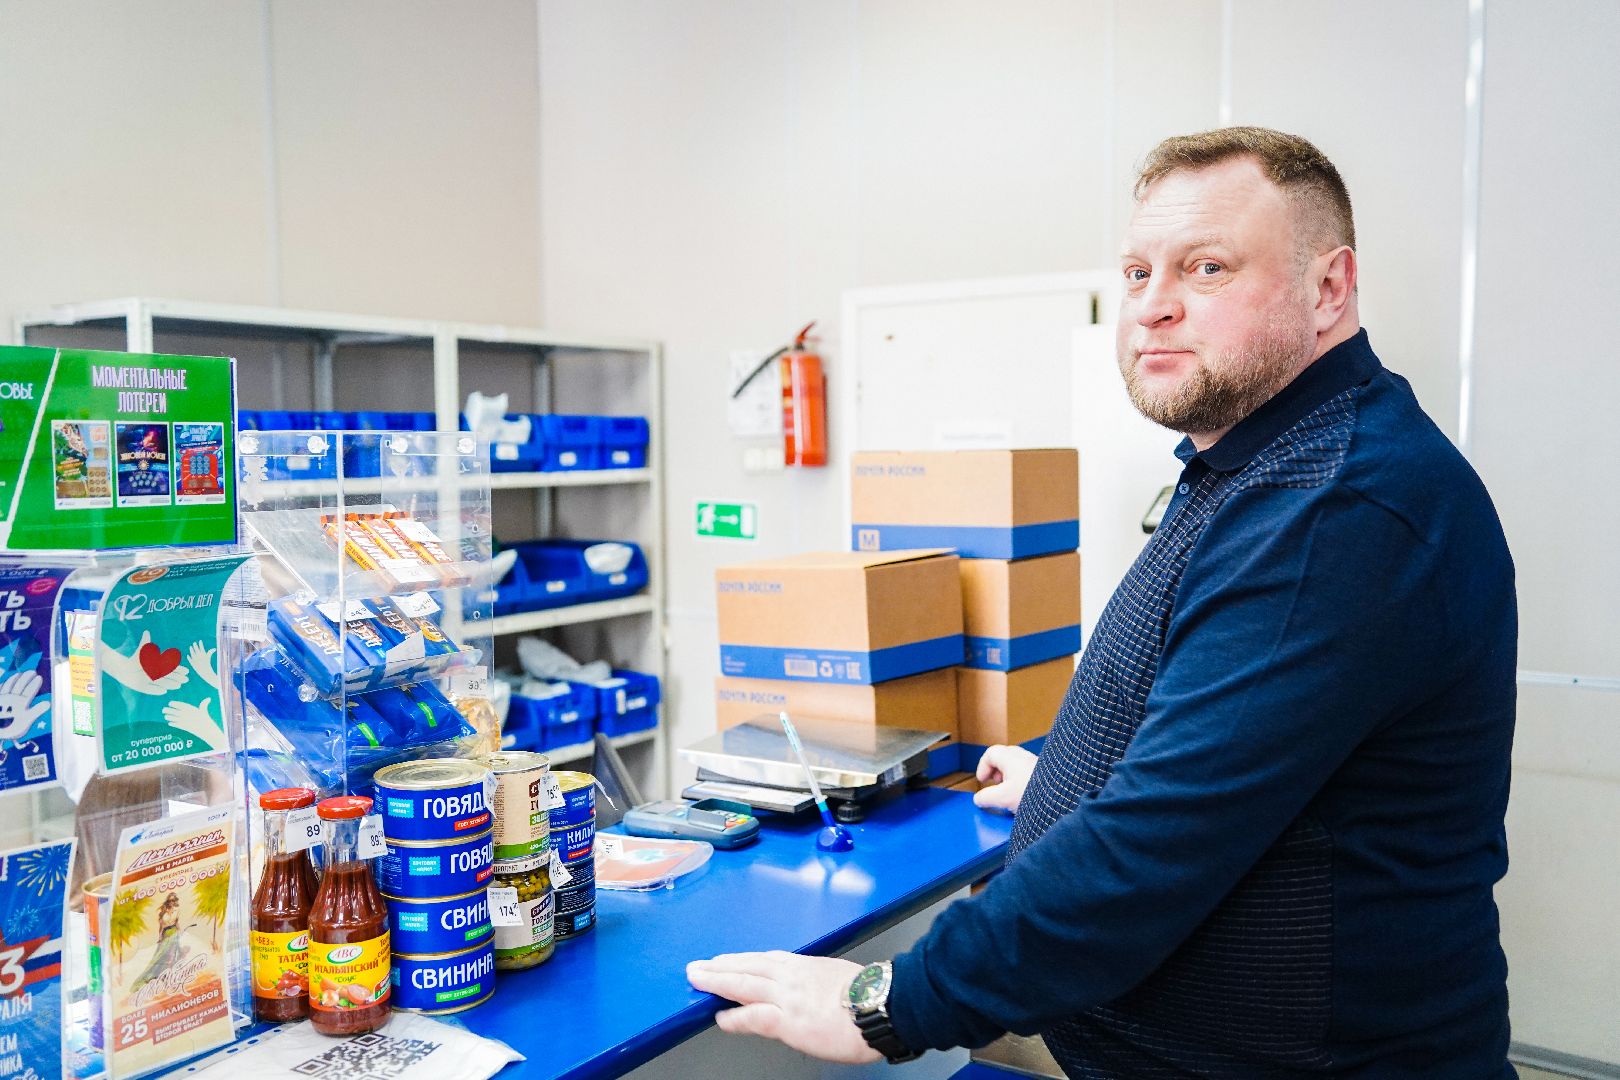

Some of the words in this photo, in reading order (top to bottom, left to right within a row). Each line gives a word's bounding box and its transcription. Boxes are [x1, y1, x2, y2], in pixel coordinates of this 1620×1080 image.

[92, 365, 188, 390] МОМЕНТАЛЬНЫЕ
[146, 596, 195, 614] ДОБРЫХ
[194, 593, 214, 609] ДЕЛ
[130, 733, 173, 748] суперприз
[111, 754, 123, 763] от
[125, 749, 139, 761] 20
[141, 745, 161, 758] 000
[164, 741, 184, 753] 000
[423, 791, 486, 819] ГОВЯД
[278, 952, 308, 964] ТАТАР
[314, 957, 379, 976] ИТАЛЬЯНСКИЙ
[411, 952, 494, 990] СВИНИНА
[121, 1007, 146, 1024] БОЛЕЕ
[151, 988, 220, 1022] МИЛЛИОНЕРОВ
[121, 1017, 149, 1045] 25
